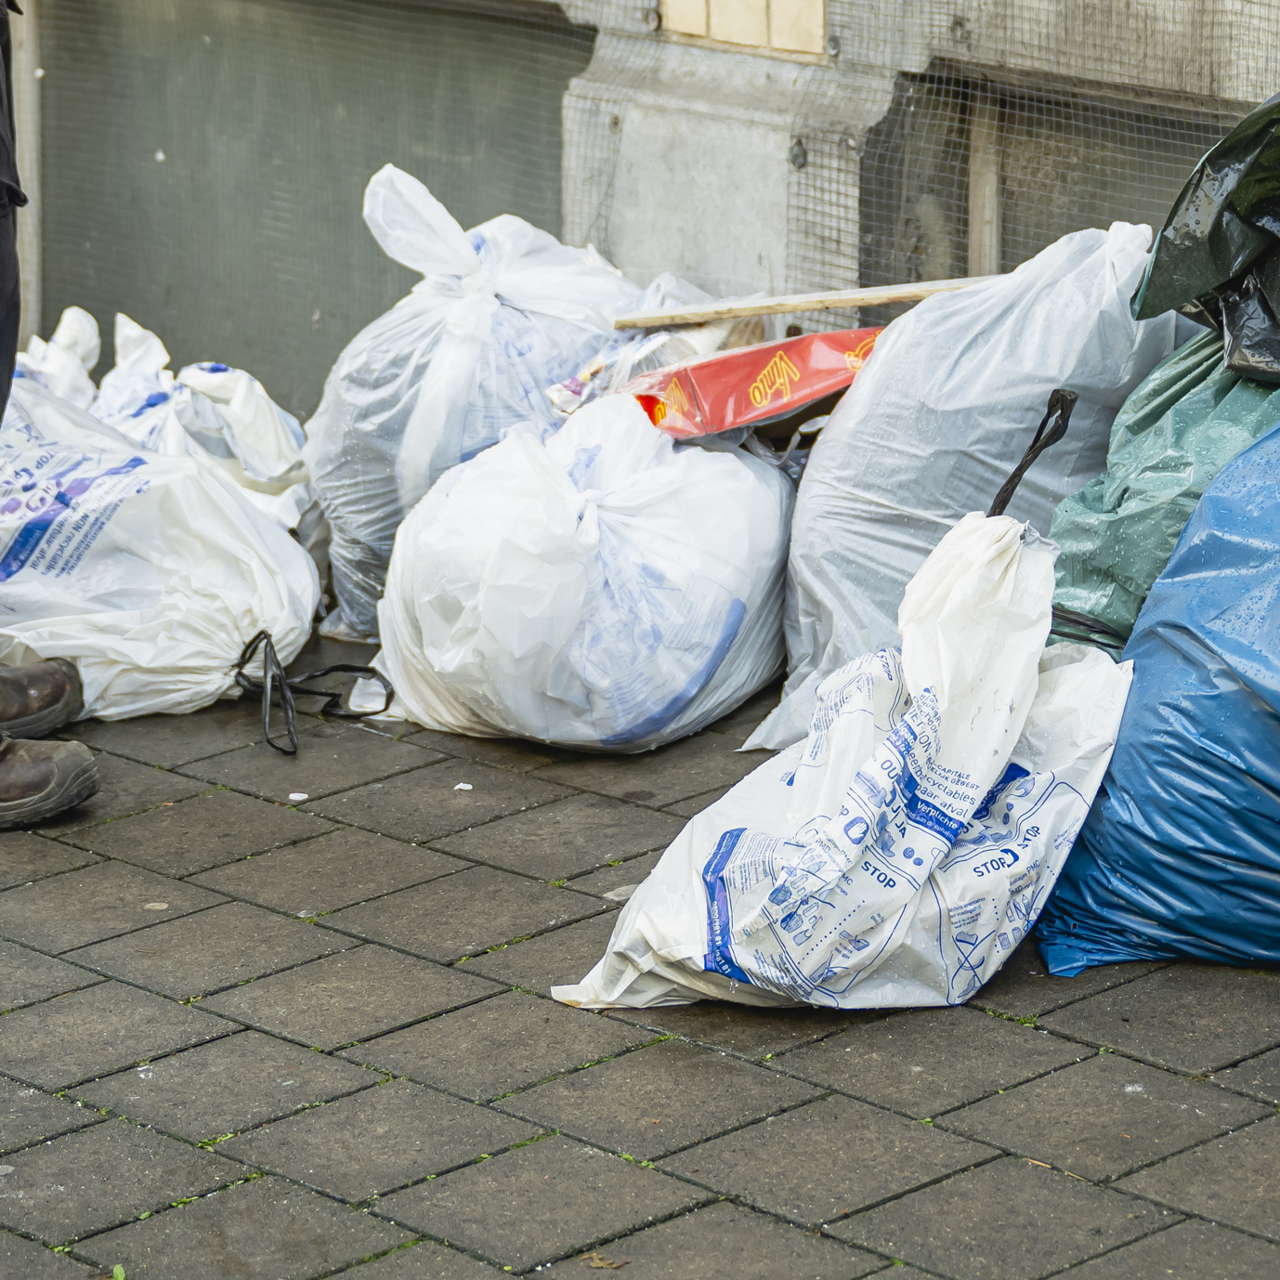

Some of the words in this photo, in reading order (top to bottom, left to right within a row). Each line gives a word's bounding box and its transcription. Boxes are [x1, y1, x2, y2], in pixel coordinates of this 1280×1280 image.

[917, 799, 960, 831] Verplichte
[860, 860, 897, 889] STOP
[972, 853, 1008, 878] STOP
